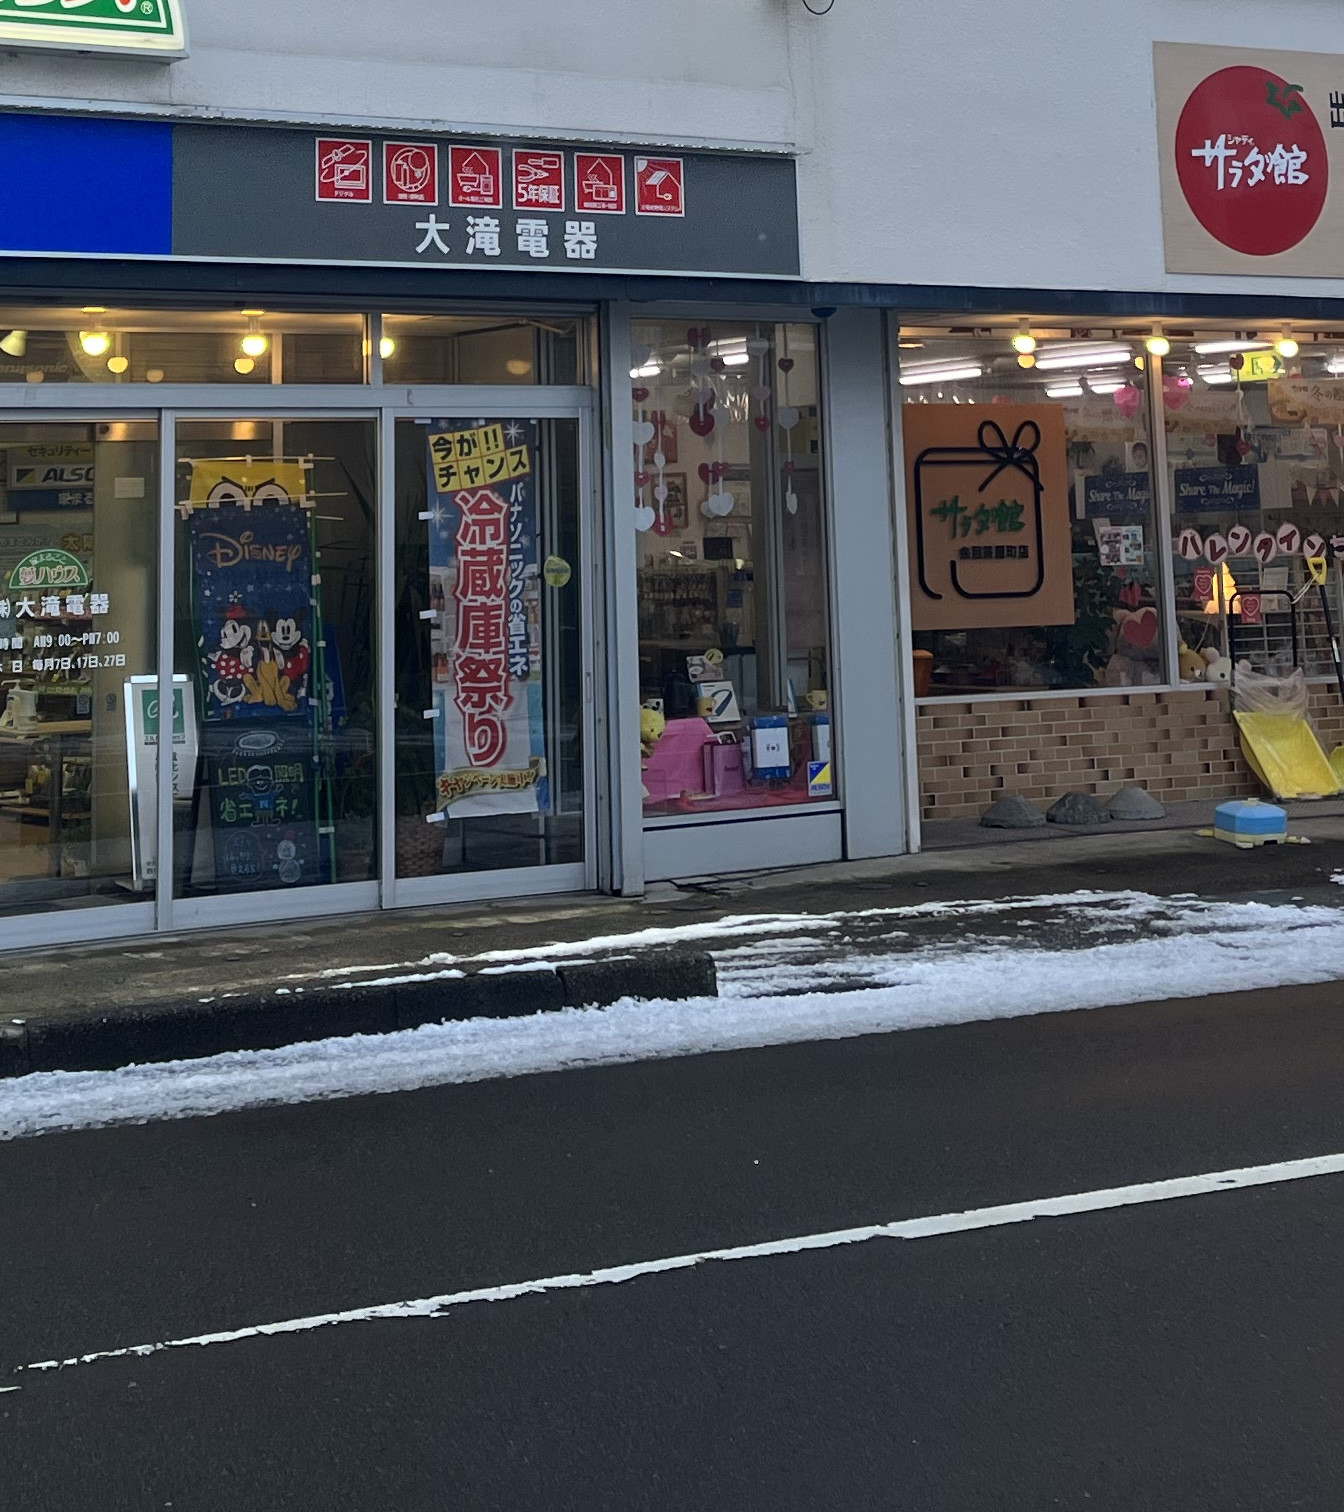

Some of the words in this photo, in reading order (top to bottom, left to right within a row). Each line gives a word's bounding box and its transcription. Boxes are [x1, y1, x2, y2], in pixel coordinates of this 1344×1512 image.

[1191, 134, 1309, 190] サラダ館
[518, 184, 560, 203] 5年保証
[415, 214, 598, 260] 大滝電器
[28, 445, 90, 458] セキュリティー
[432, 428, 499, 460] 今が!!
[439, 449, 527, 488] チャンス
[1089, 489, 1111, 503] Share
[1114, 491, 1125, 499] The
[1179, 483, 1206, 497] Share
[1208, 484, 1220, 493] The
[1221, 479, 1255, 497] Magic!
[509, 482, 530, 677] パナソニックの省エネ
[455, 490, 508, 766] 冷蔵庫祭り
